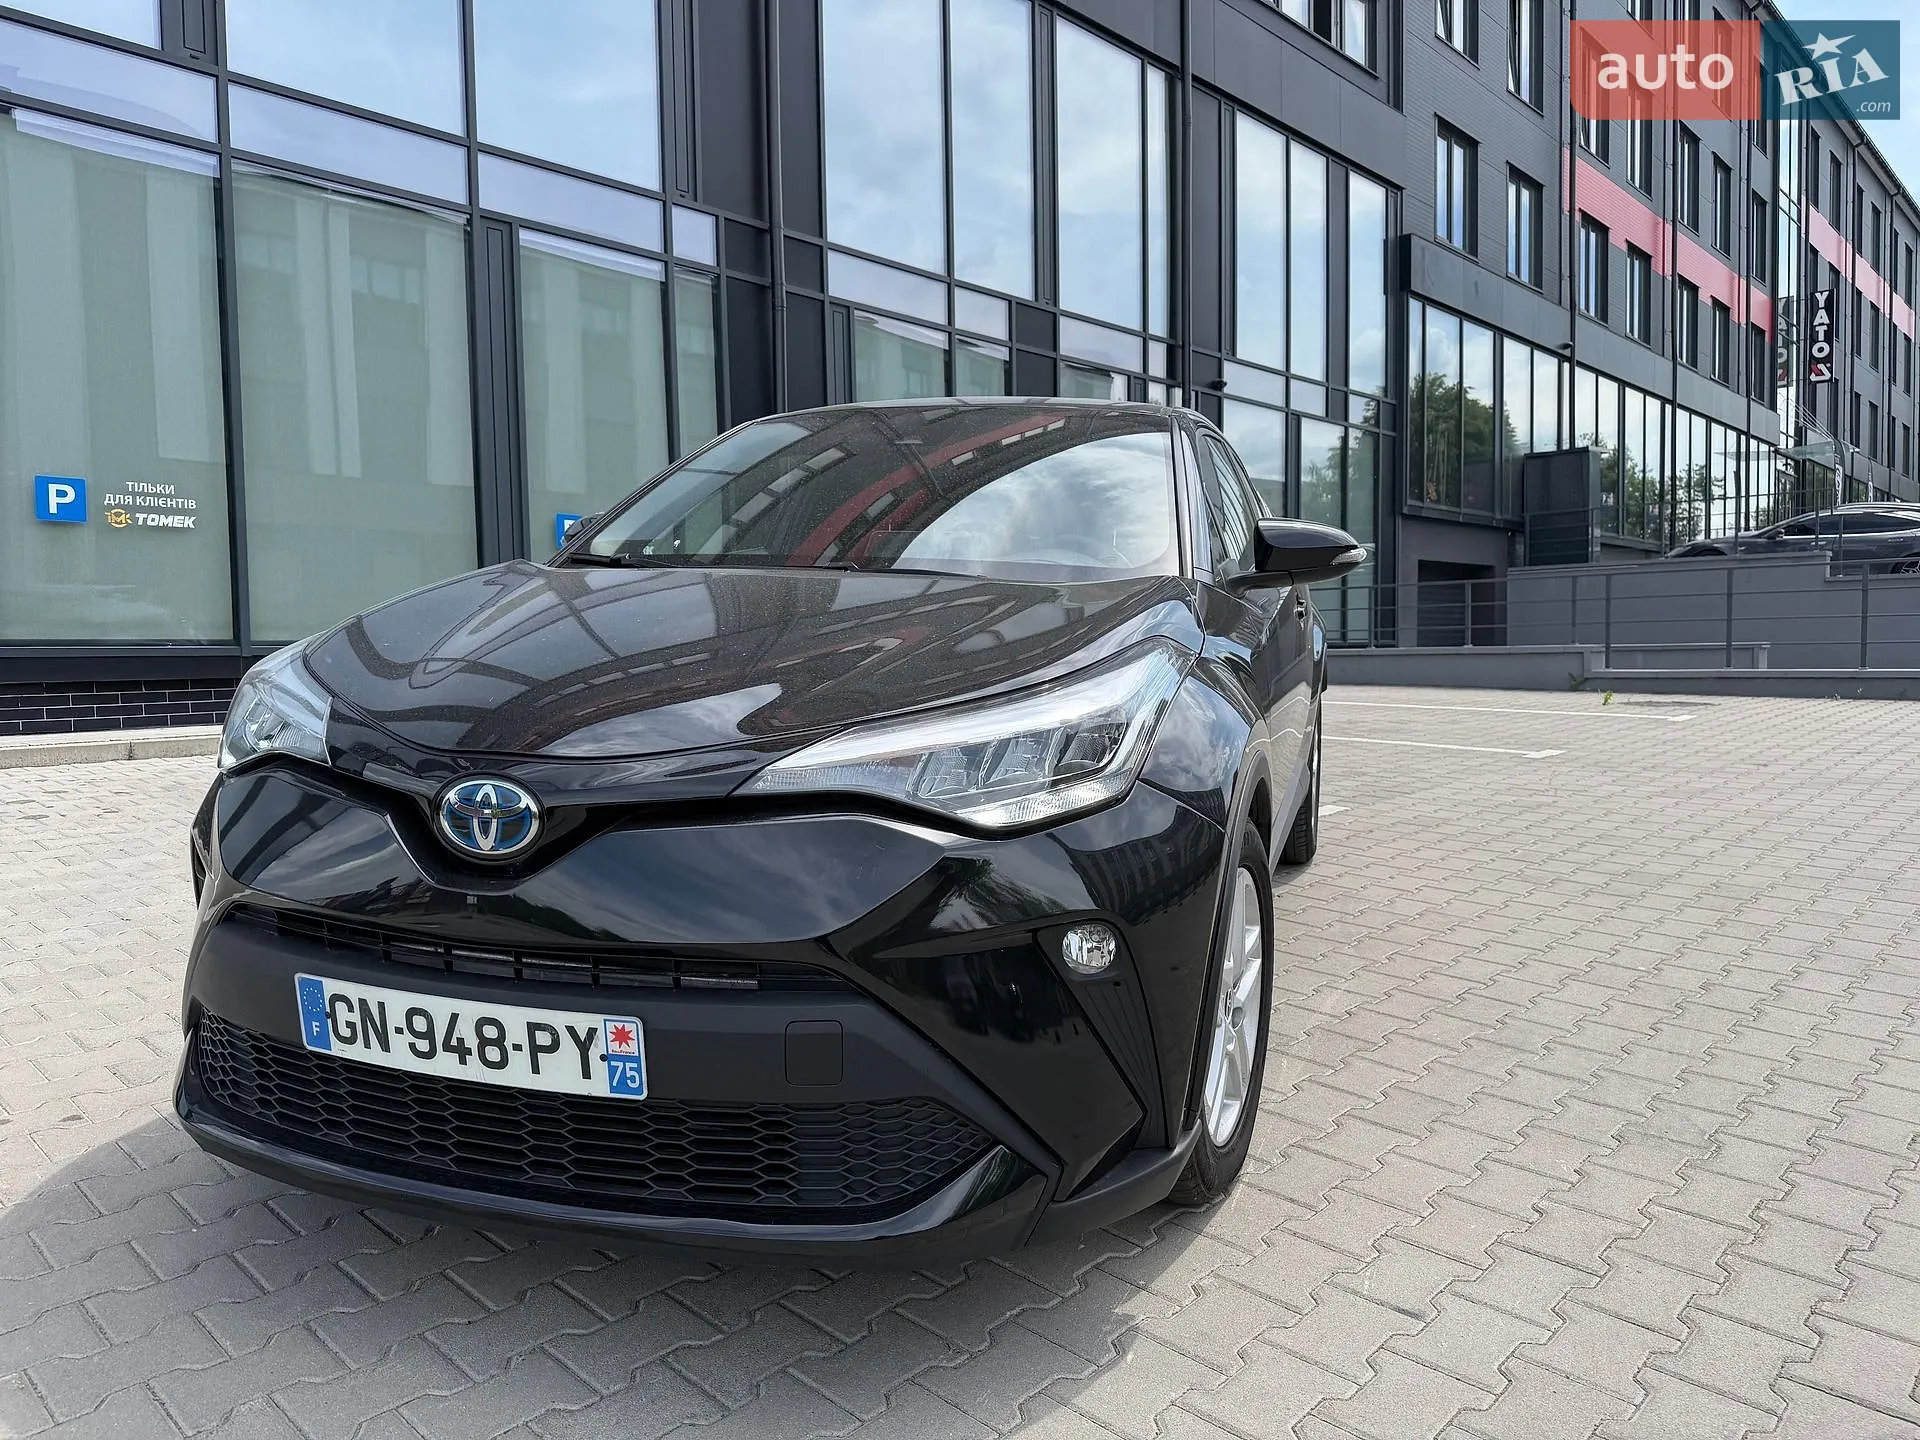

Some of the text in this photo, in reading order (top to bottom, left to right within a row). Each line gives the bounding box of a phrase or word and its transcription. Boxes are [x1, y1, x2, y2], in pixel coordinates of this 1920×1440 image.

[48, 483, 76, 514] P
[125, 481, 175, 495] ТІЛЬКИ
[103, 493, 197, 510] ДЛЯ КЛІЄНТІВ
[312, 1021, 321, 1037] F
[329, 993, 599, 1081] GN-948-PY
[610, 1061, 640, 1089] 75
